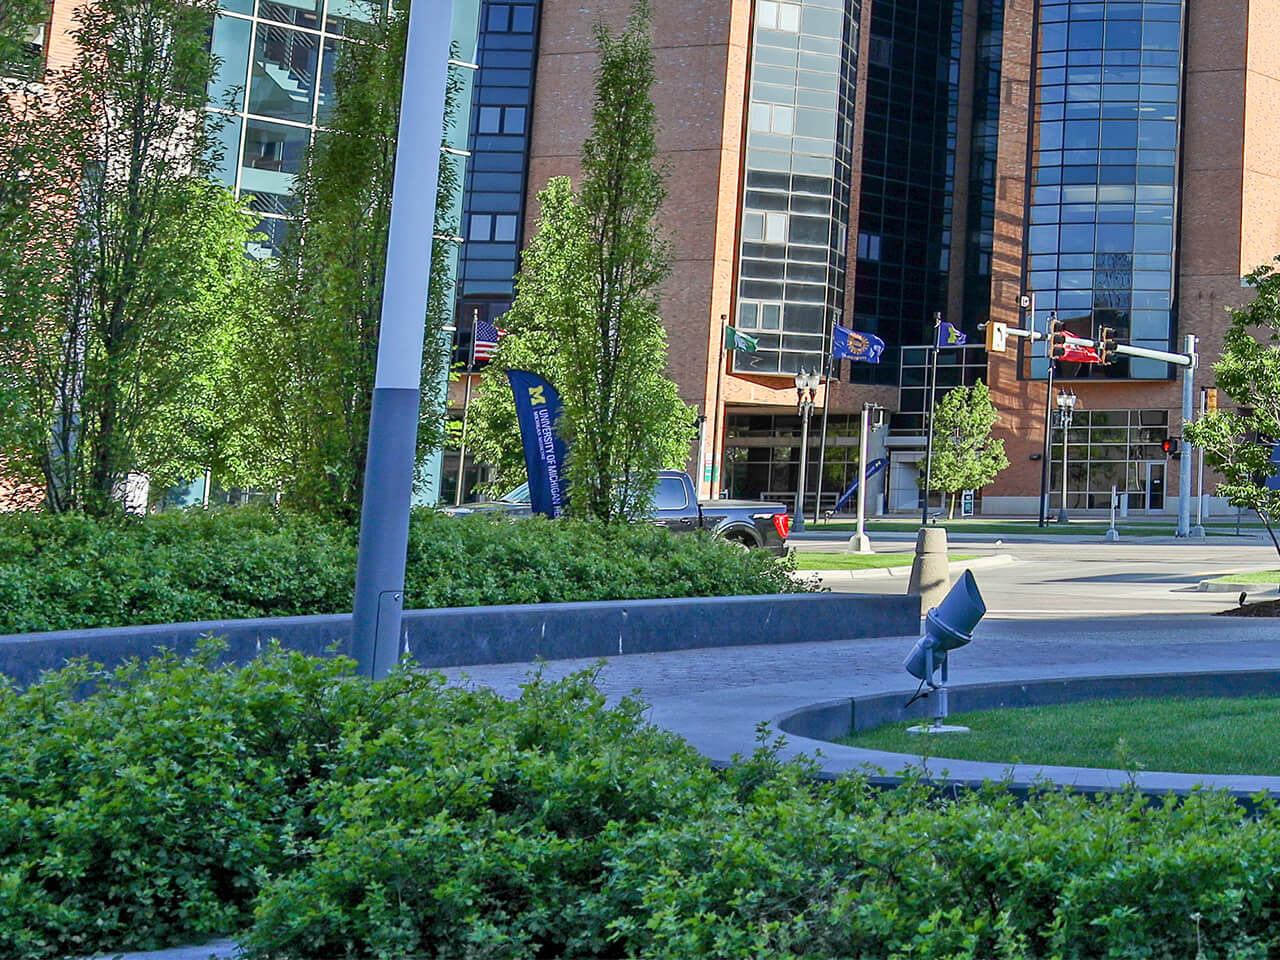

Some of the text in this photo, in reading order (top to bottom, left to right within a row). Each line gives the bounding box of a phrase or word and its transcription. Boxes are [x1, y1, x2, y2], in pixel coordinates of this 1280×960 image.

[528, 385, 546, 406] M
[539, 409, 555, 454] UNIVERSITY
[546, 454, 557, 465] OF
[548, 465, 561, 505] MICHIGAN
